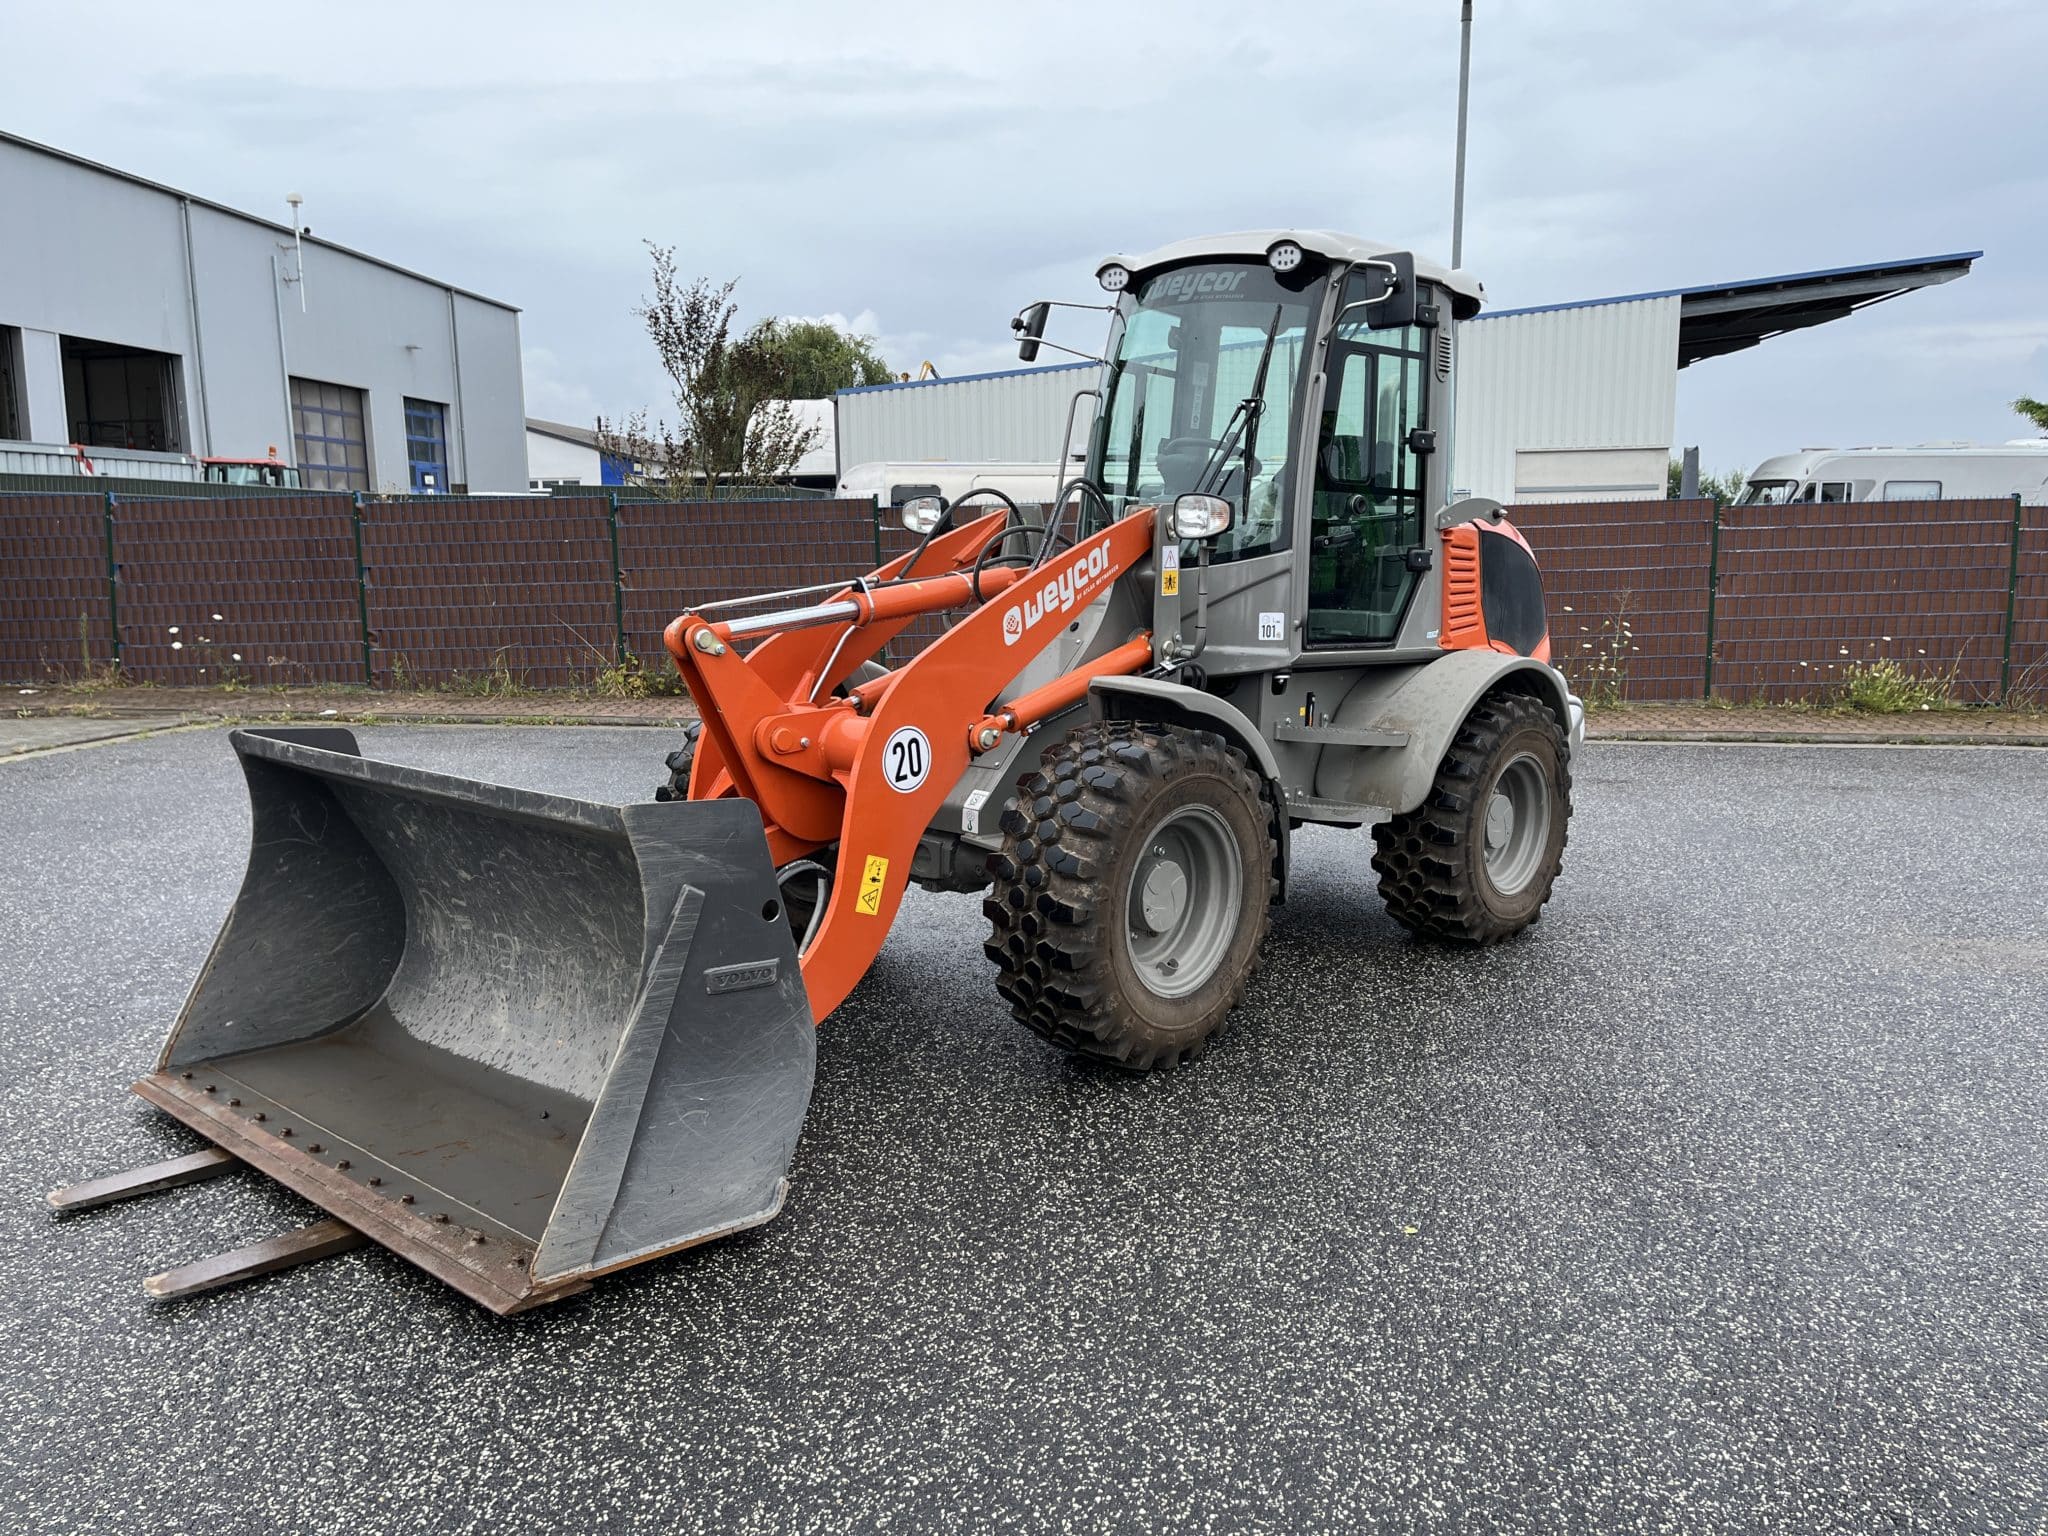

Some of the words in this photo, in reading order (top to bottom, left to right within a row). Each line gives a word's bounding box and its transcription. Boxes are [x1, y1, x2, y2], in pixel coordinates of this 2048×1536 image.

[1150, 271, 1248, 301] weycor
[1023, 538, 1110, 630] weycor
[1262, 624, 1276, 638] 101
[892, 737, 922, 783] 20
[715, 968, 773, 986] VOLVO
